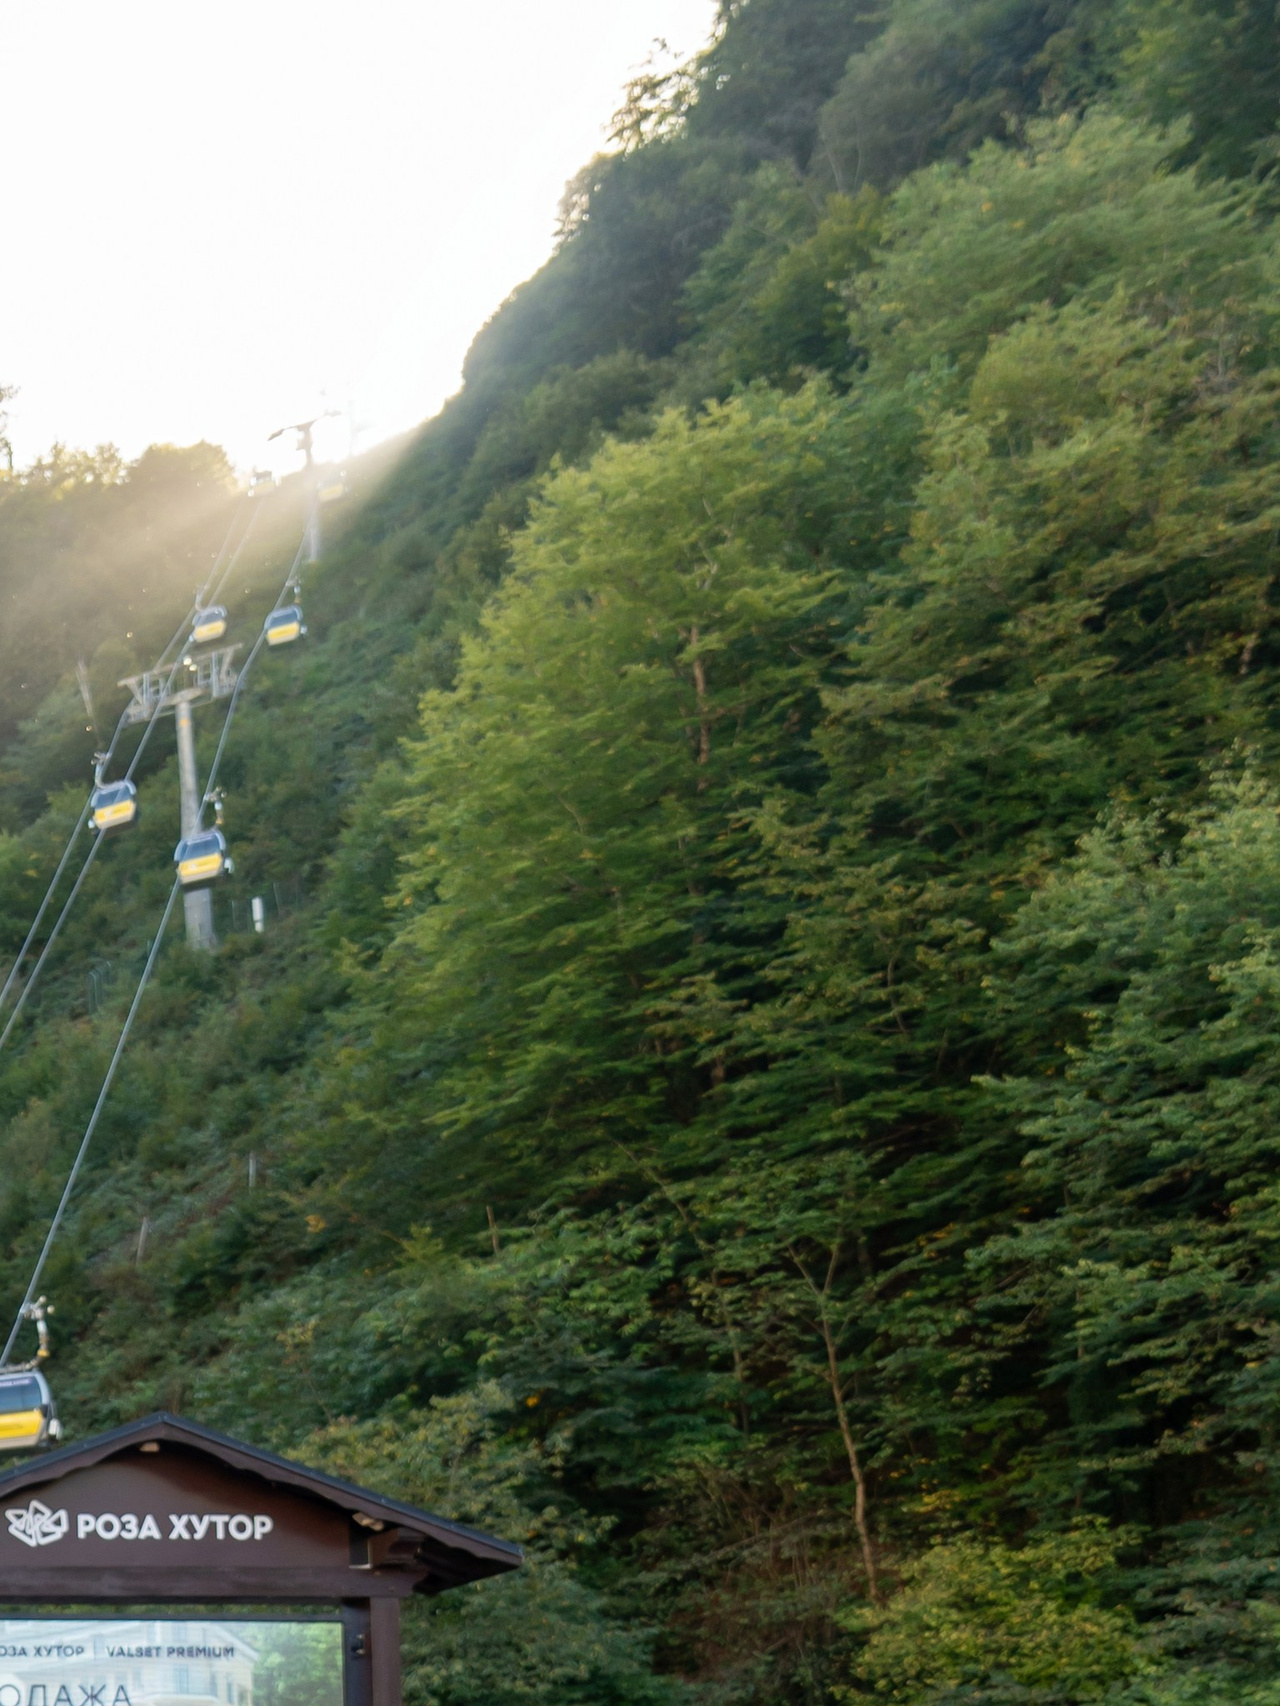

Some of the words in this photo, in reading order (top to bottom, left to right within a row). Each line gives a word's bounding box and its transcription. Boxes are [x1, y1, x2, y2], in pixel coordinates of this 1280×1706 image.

[77, 1513, 162, 1540] РОЗА
[168, 1514, 274, 1541] ХУТОР
[33, 1645, 85, 1658] ХУТОР
[106, 1645, 161, 1658] VALSET
[166, 1645, 235, 1658] PREMIUM
